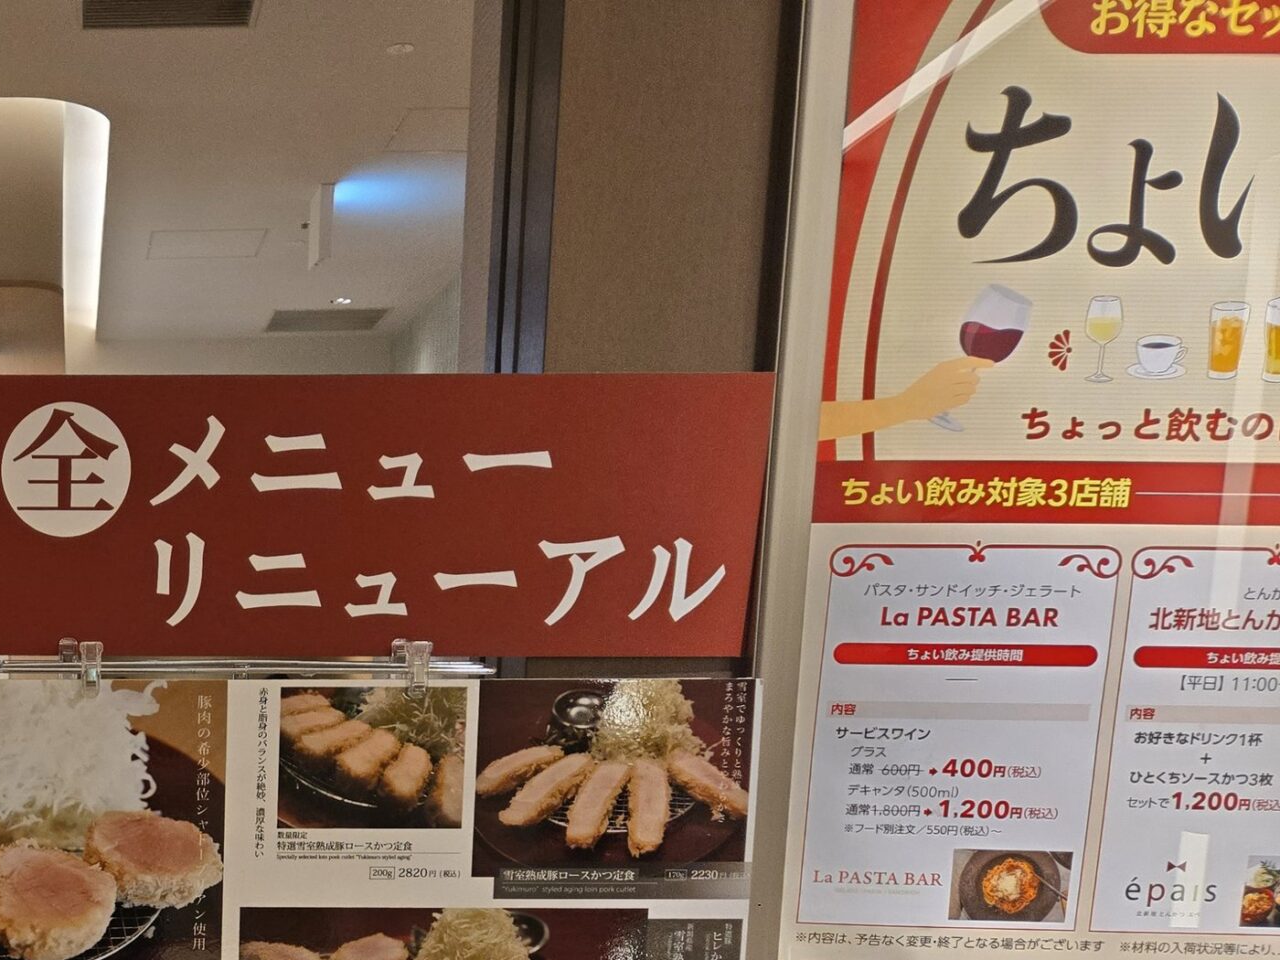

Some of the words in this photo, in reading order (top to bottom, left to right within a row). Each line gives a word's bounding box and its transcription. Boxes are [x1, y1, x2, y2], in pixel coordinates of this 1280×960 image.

[1022, 407, 1280, 443] ちょっと飲むの
[12, 407, 120, 512] 全
[148, 414, 553, 507] メニュー
[841, 477, 1131, 508] ちょい飲み対象3店舗
[151, 530, 728, 627] リニューアル
[864, 583, 1081, 599] パスタ・サンドイッチ・ジェラート
[880, 606, 909, 627] La
[917, 606, 998, 627] PASTA
[1006, 607, 1059, 628] BAR
[907, 648, 1024, 662] ちょい飲み提供時間
[1232, 677, 1280, 692] 11:00
[830, 704, 856, 716] 内容
[1129, 708, 1155, 720] 内容
[835, 726, 931, 741] サービスワイン
[1134, 732, 1263, 746] お好きなドリンク1杯
[850, 746, 887, 758] グラス
[848, 763, 873, 775] 通常
[1130, 771, 1273, 786] ひとくちソースかつ3枚
[372, 869, 393, 879] 200g
[813, 870, 833, 883] La
[838, 870, 899, 885] PASTA
[904, 872, 943, 886] BAR
[1125, 877, 1217, 907] épais
[1120, 941, 1280, 956] ※材料の入荷状況等により、
